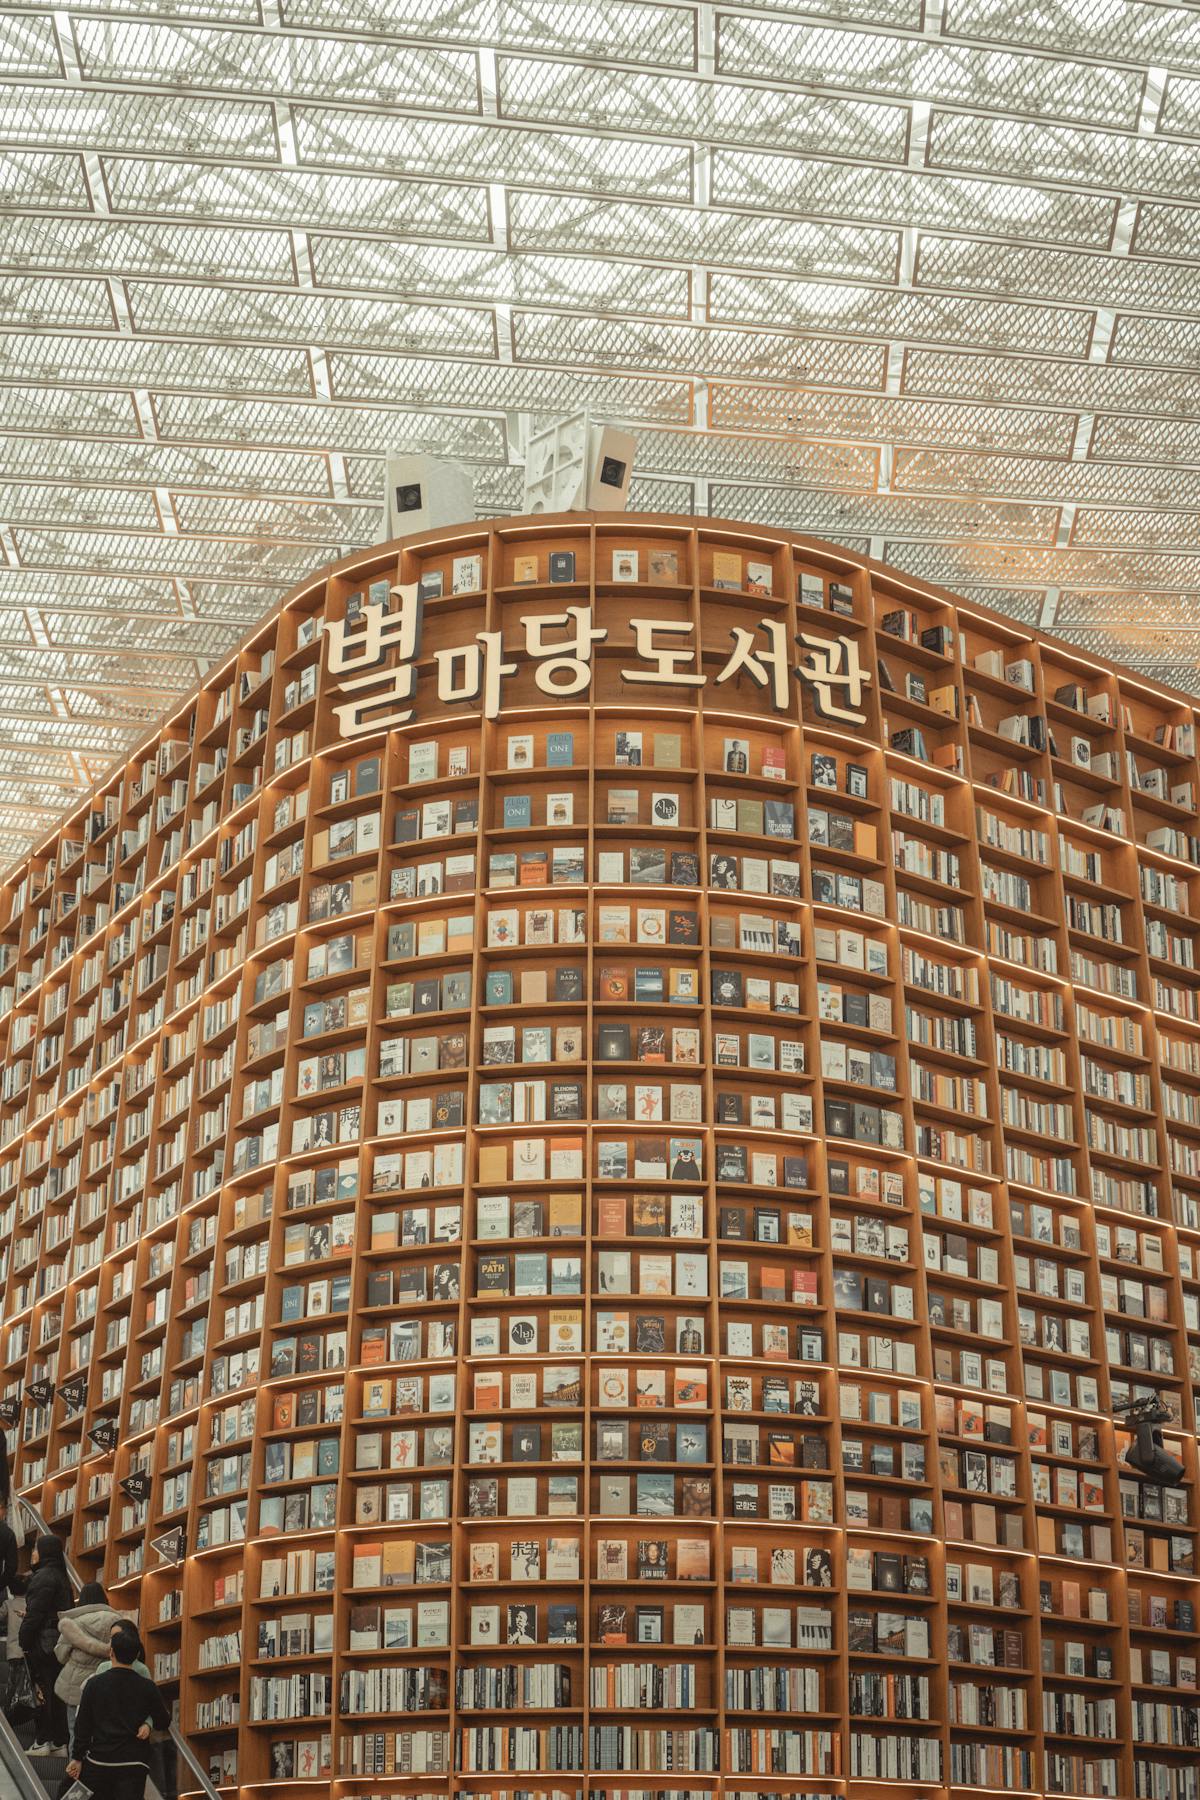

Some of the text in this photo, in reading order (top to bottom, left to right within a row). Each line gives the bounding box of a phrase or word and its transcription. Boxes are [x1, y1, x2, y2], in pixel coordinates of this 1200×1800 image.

[323, 582, 872, 739] 별마당 도서관
[550, 744, 569, 753] ONE
[507, 807, 527, 817] ONE
[481, 1264, 505, 1273] PATH
[95, 1430, 110, 1441] 주의
[128, 1479, 143, 1490] 주의
[735, 1500, 758, 1511] 군함도
[161, 1539, 178, 1550] 주의
